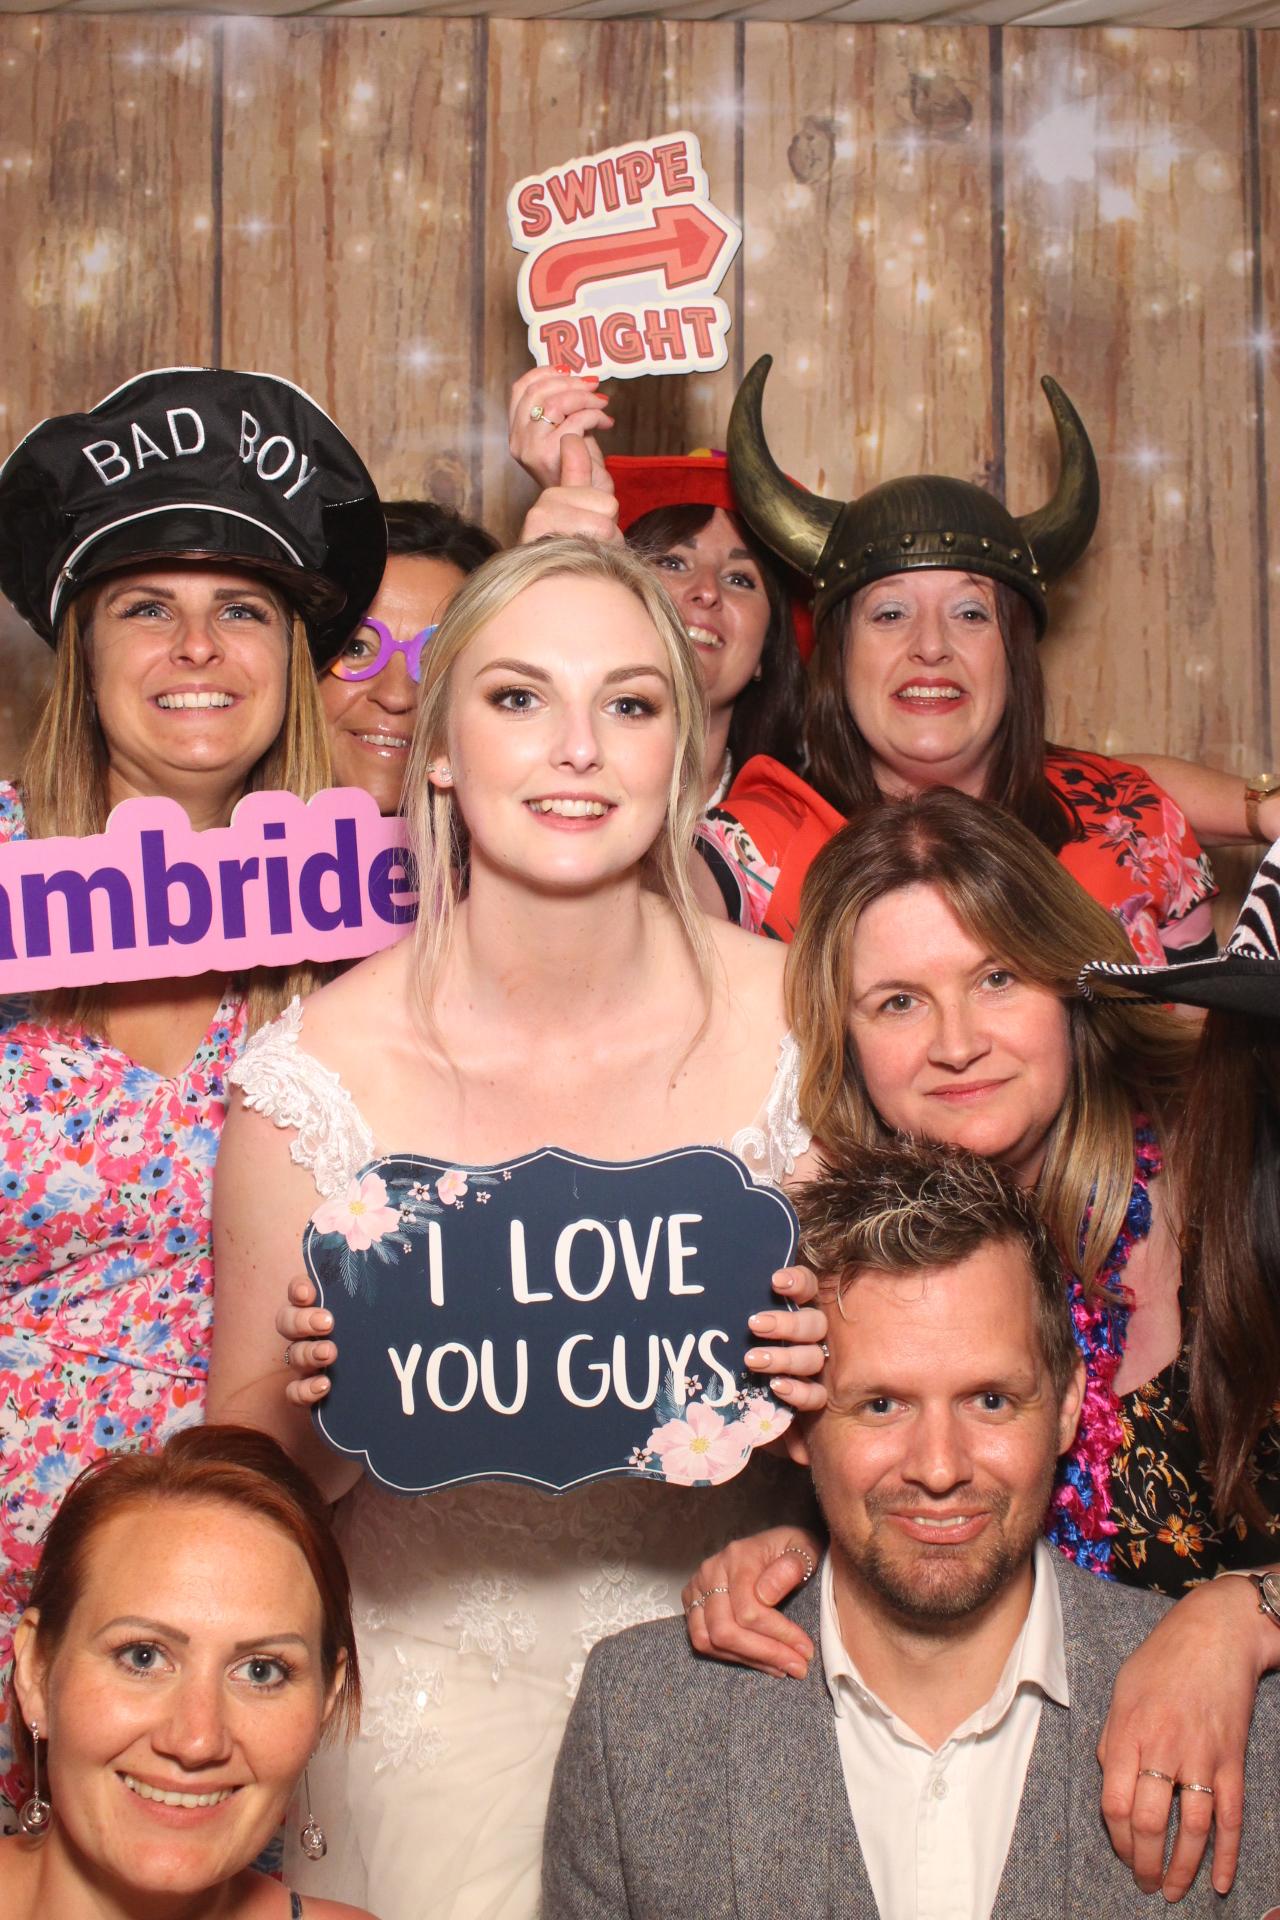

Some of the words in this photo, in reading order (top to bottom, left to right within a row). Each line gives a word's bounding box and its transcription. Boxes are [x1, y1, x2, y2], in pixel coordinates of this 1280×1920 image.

[518, 141, 695, 237] SWIPE
[540, 307, 716, 373] RIGHT
[82, 407, 205, 486] BAD
[239, 410, 318, 500] BOY
[428, 1221, 444, 1306] I
[510, 1213, 705, 1304] LOVE
[388, 1336, 528, 1415] YOU
[557, 1329, 736, 1411] GUYS
